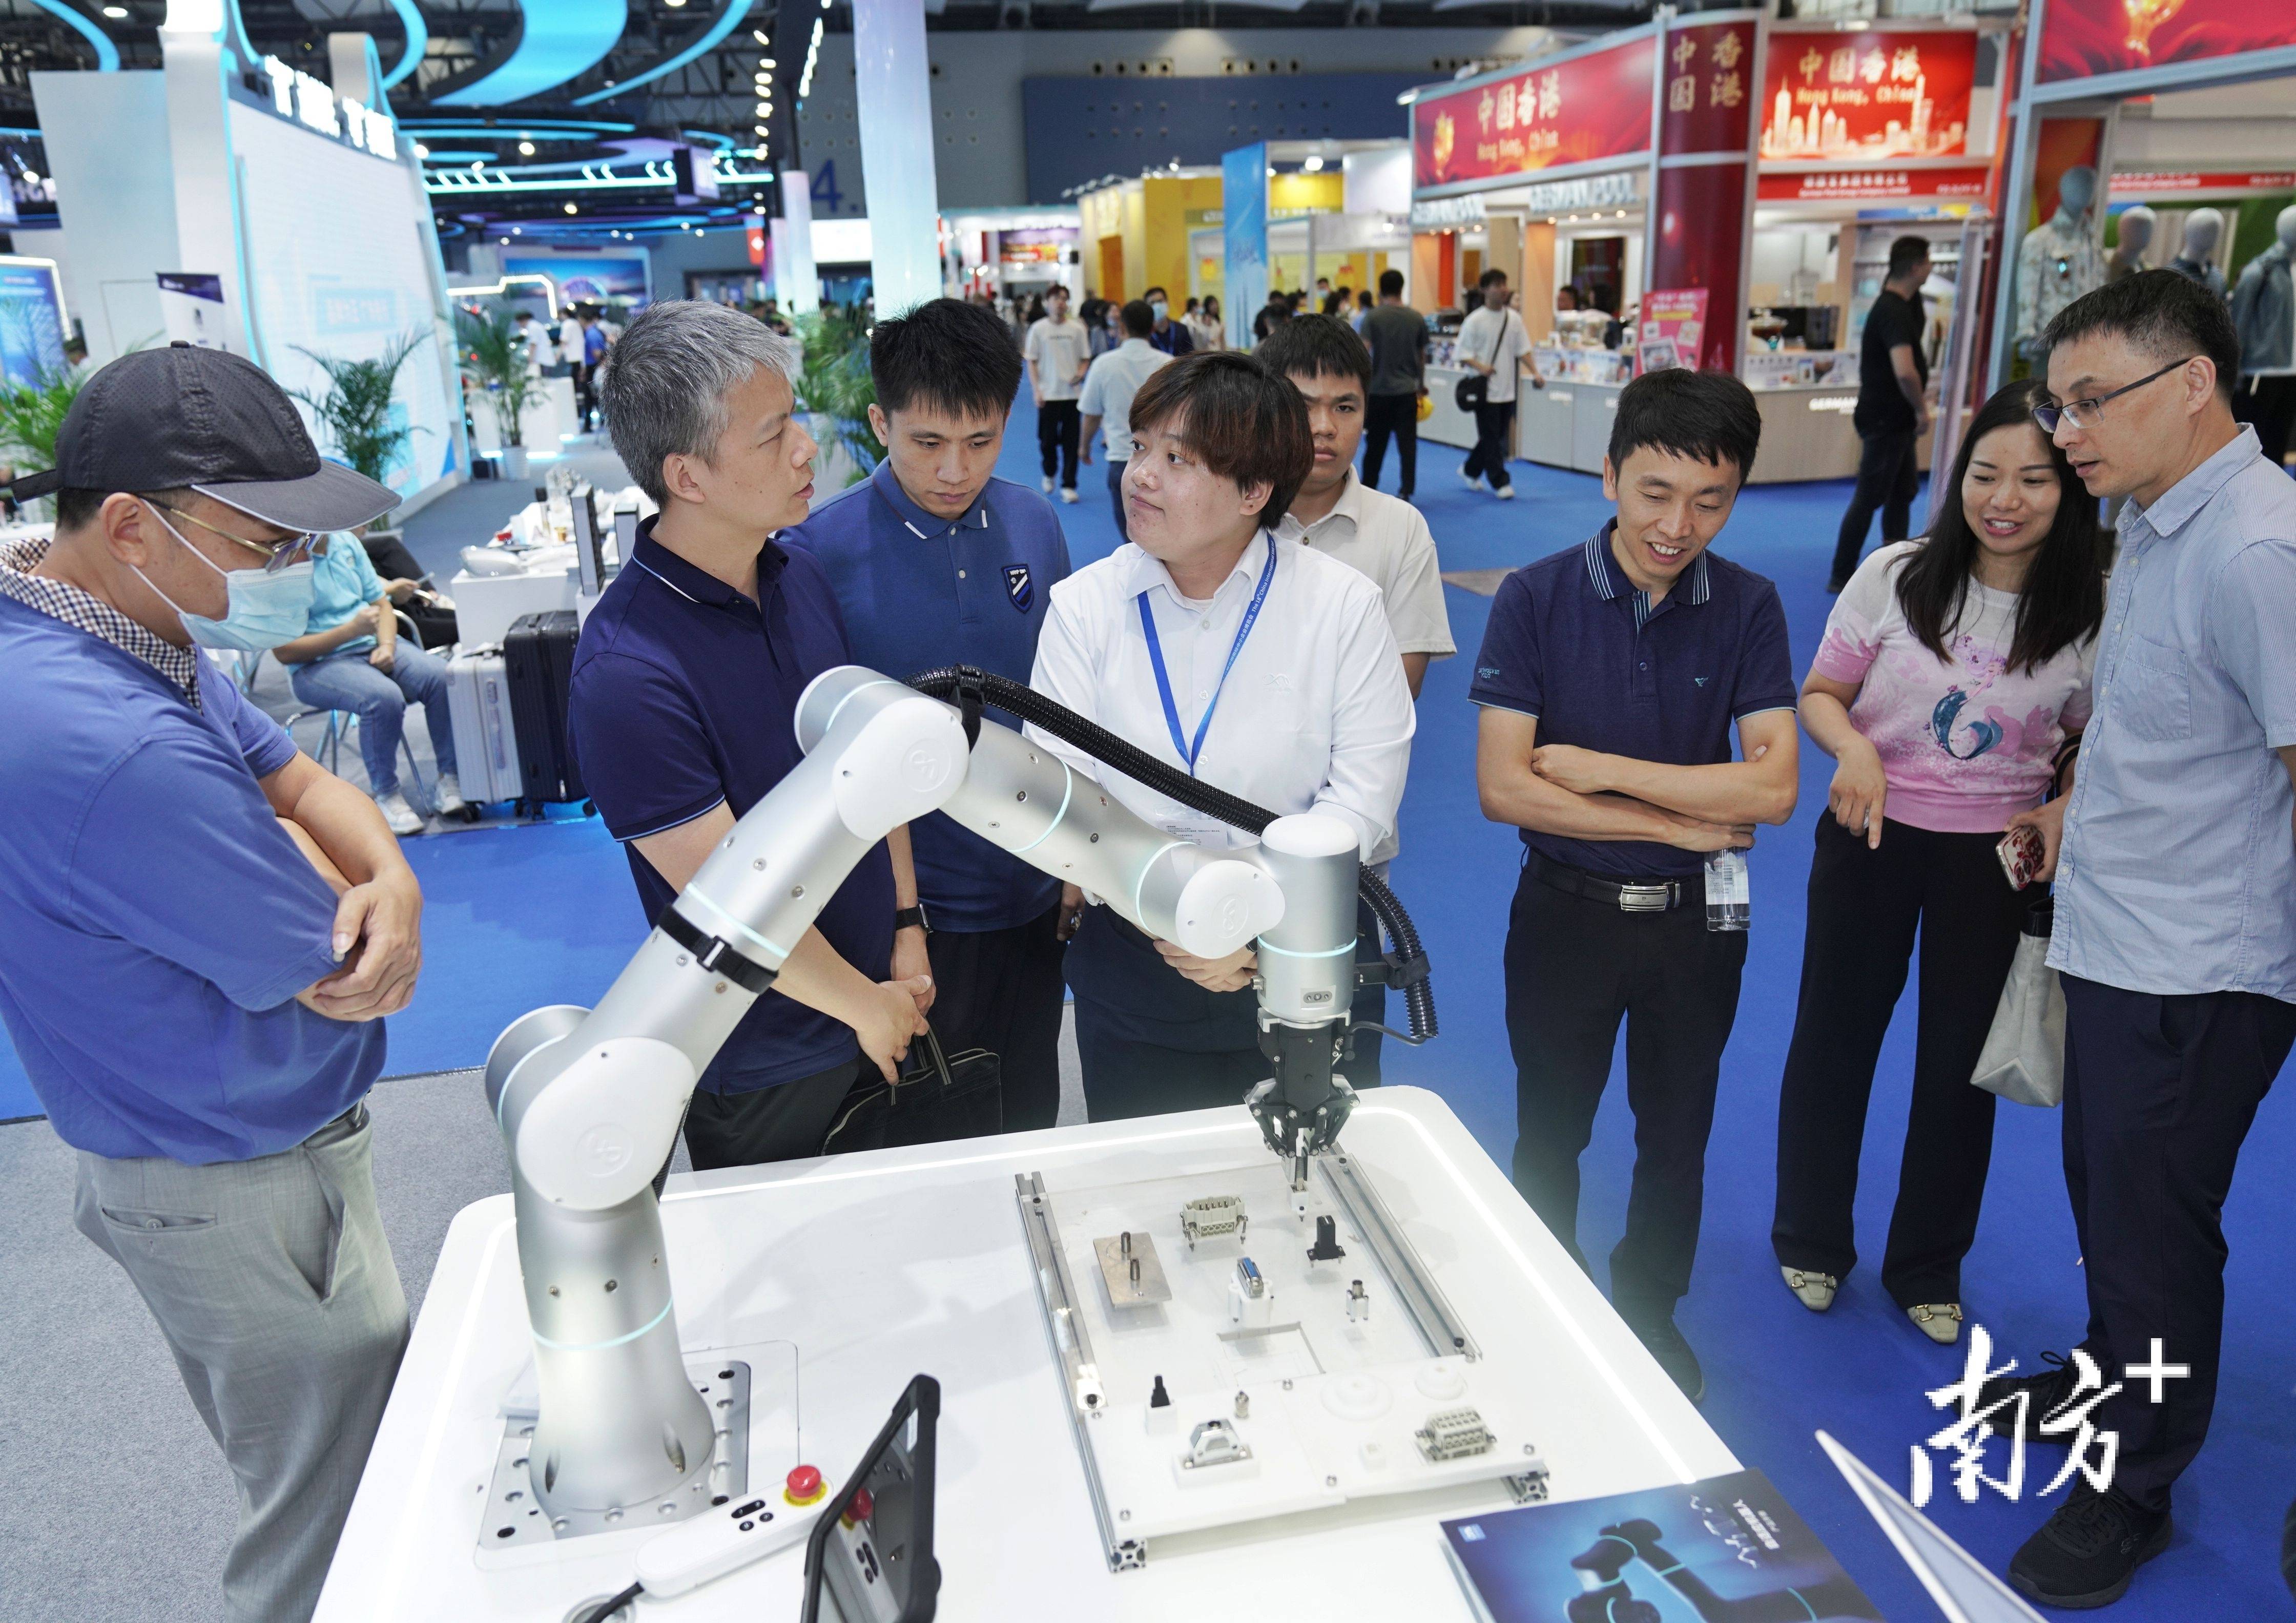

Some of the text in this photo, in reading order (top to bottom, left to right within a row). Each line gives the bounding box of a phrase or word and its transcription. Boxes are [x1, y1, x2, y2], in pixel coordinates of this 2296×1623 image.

[1799, 45, 1920, 86] 中国香港
[1477, 70, 1561, 134] 中国香港
[1796, 87, 1827, 106] Hong
[1259, 581, 1268, 595] China
[1266, 554, 1275, 582] International
